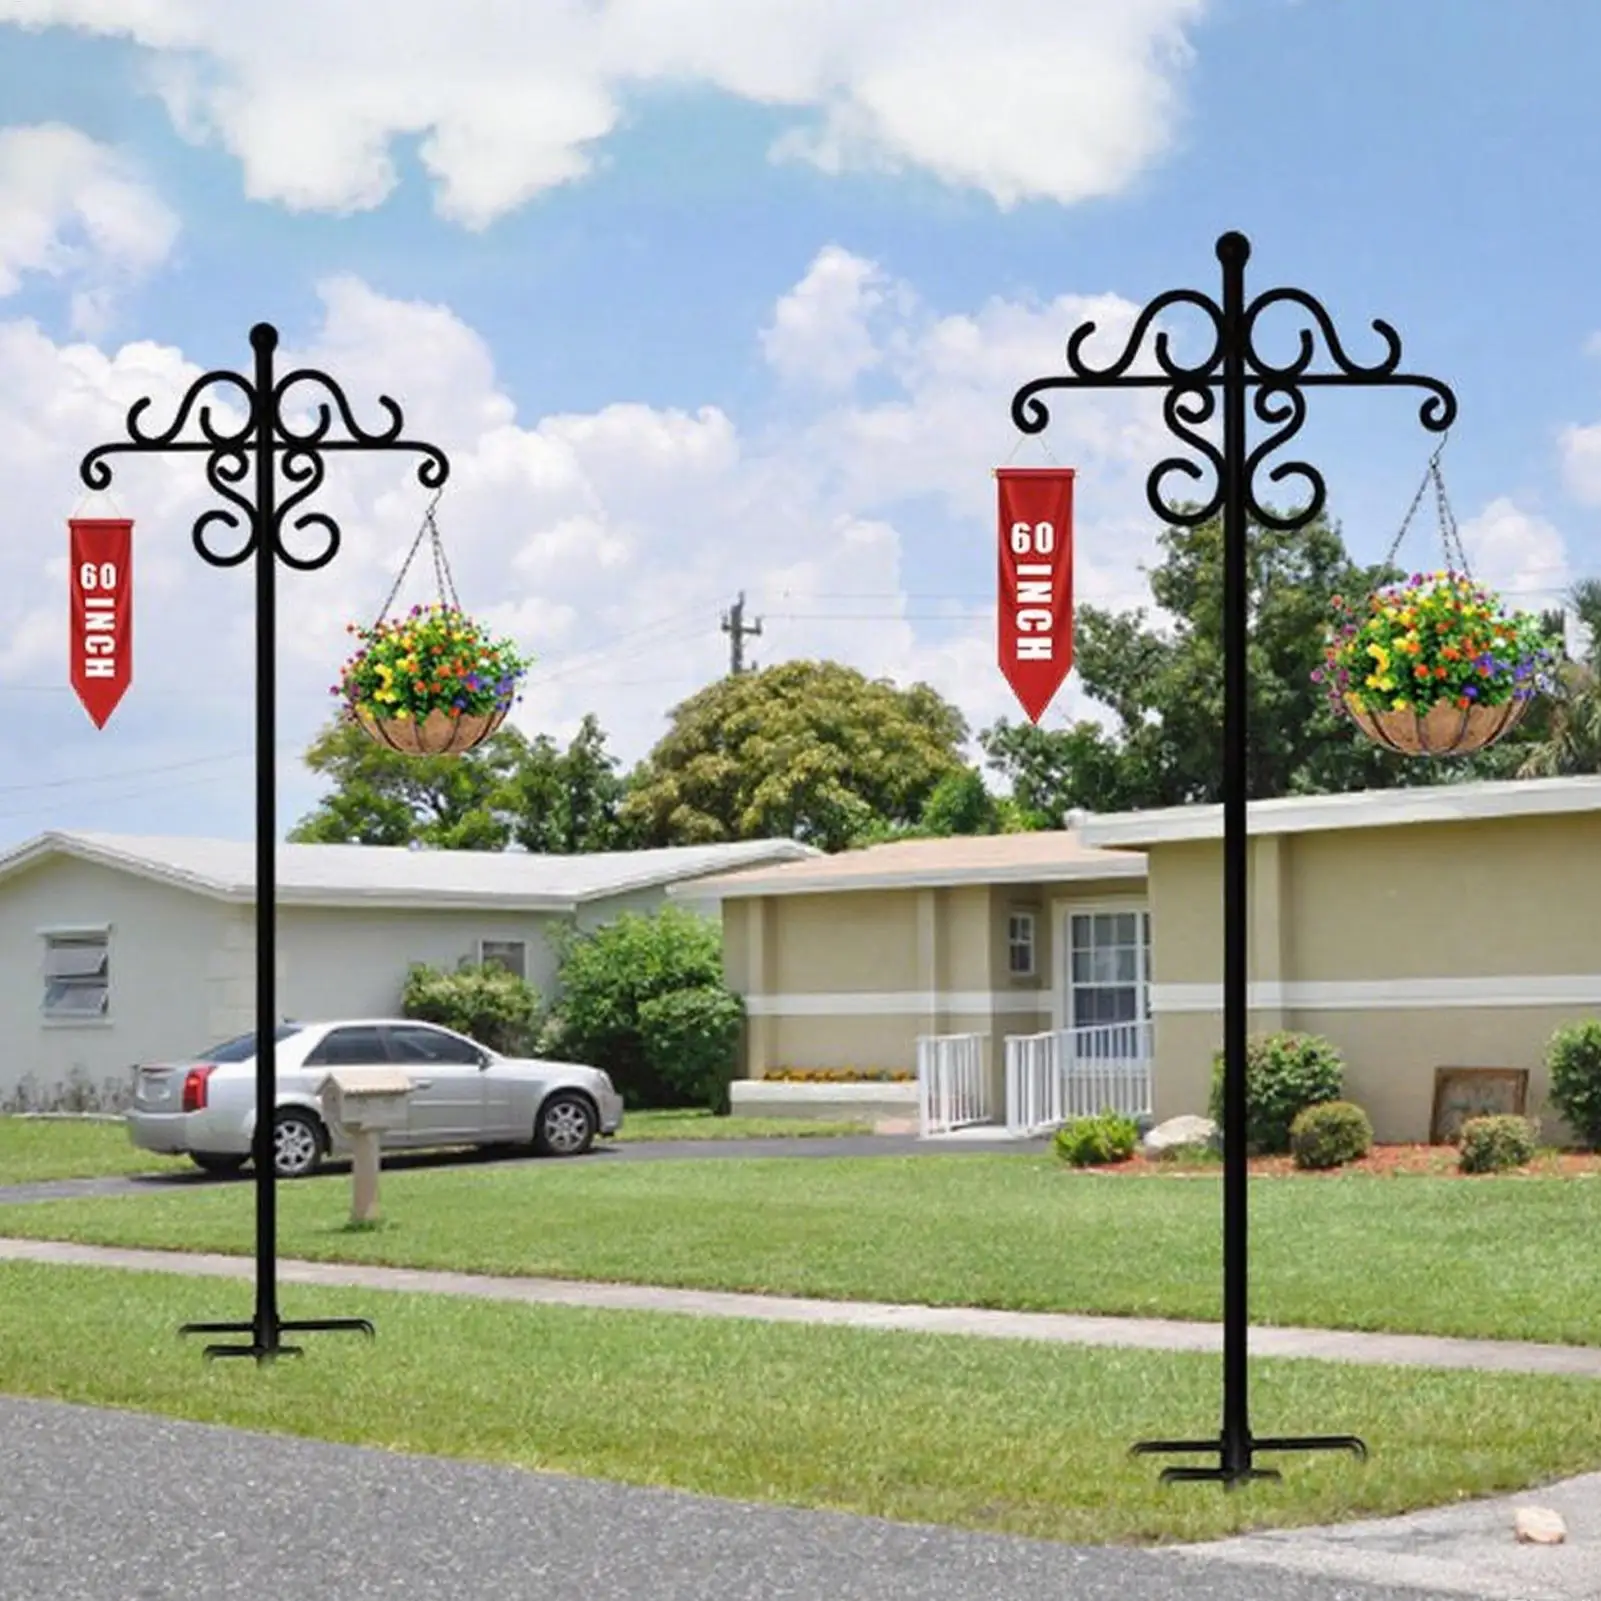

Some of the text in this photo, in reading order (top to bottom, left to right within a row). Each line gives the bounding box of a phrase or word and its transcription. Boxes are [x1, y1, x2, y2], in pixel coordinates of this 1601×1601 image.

[1011, 521, 1055, 554] 60
[80, 562, 117, 590] 60
[85, 597, 116, 678] INCH
[1016, 564, 1053, 660] INCH
